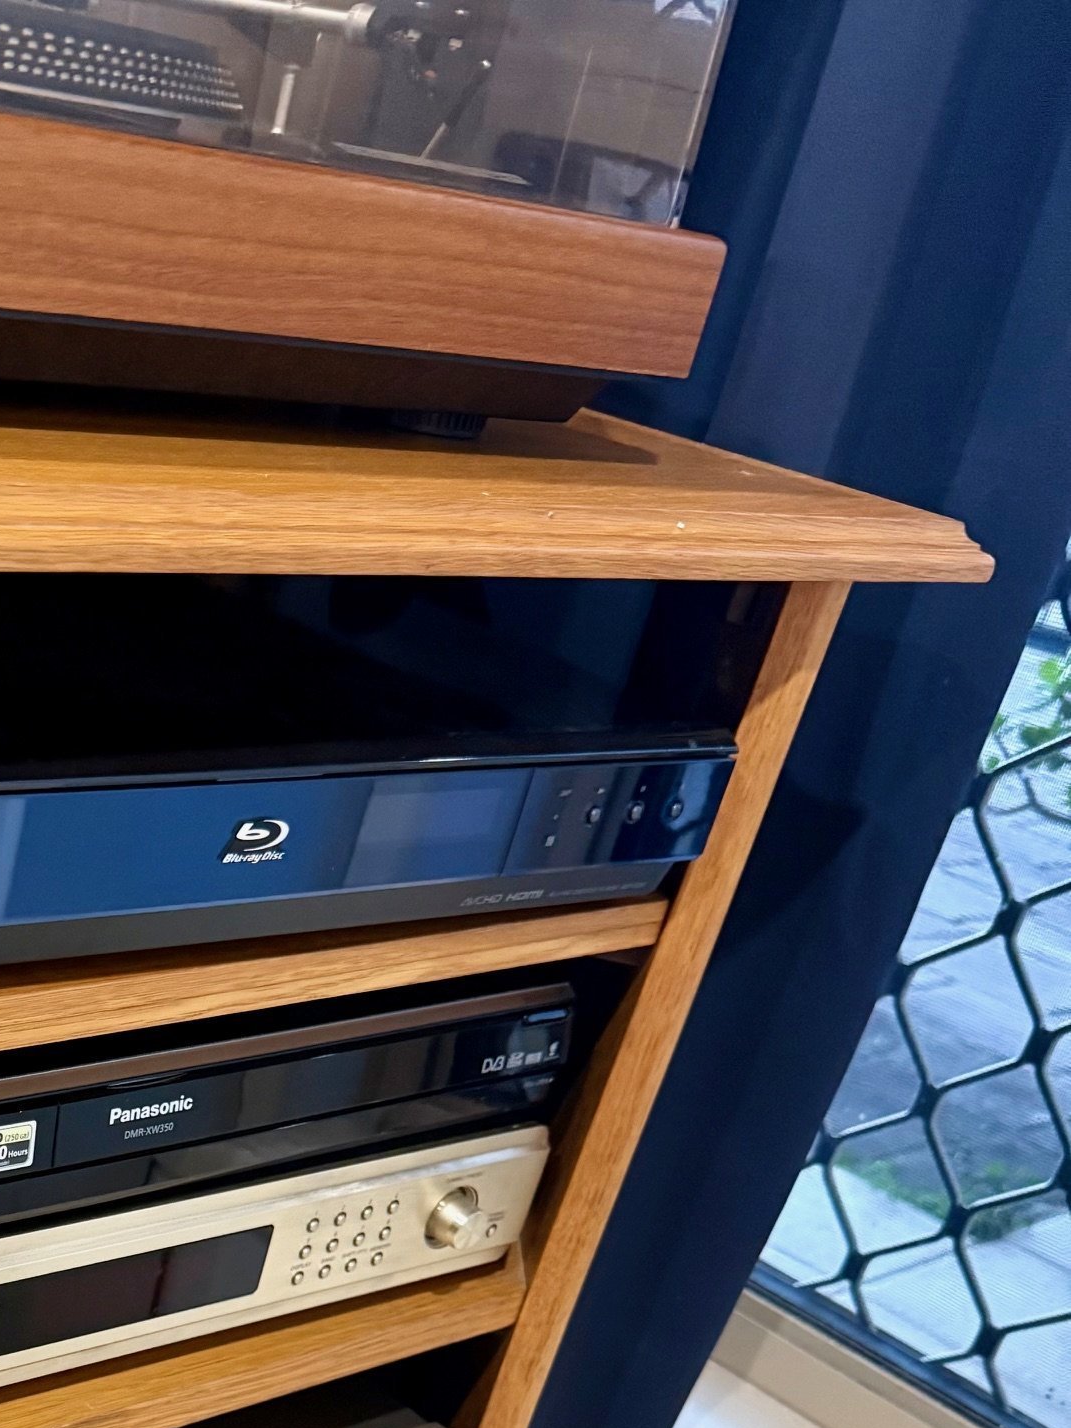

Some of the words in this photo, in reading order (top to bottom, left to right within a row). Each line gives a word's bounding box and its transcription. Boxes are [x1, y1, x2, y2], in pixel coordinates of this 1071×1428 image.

[262, 851, 286, 861] Disc
[109, 1095, 193, 1125] Panasonic
[124, 1121, 174, 1140] DMR-XW350
[8, 1148, 29, 1159] Hours
